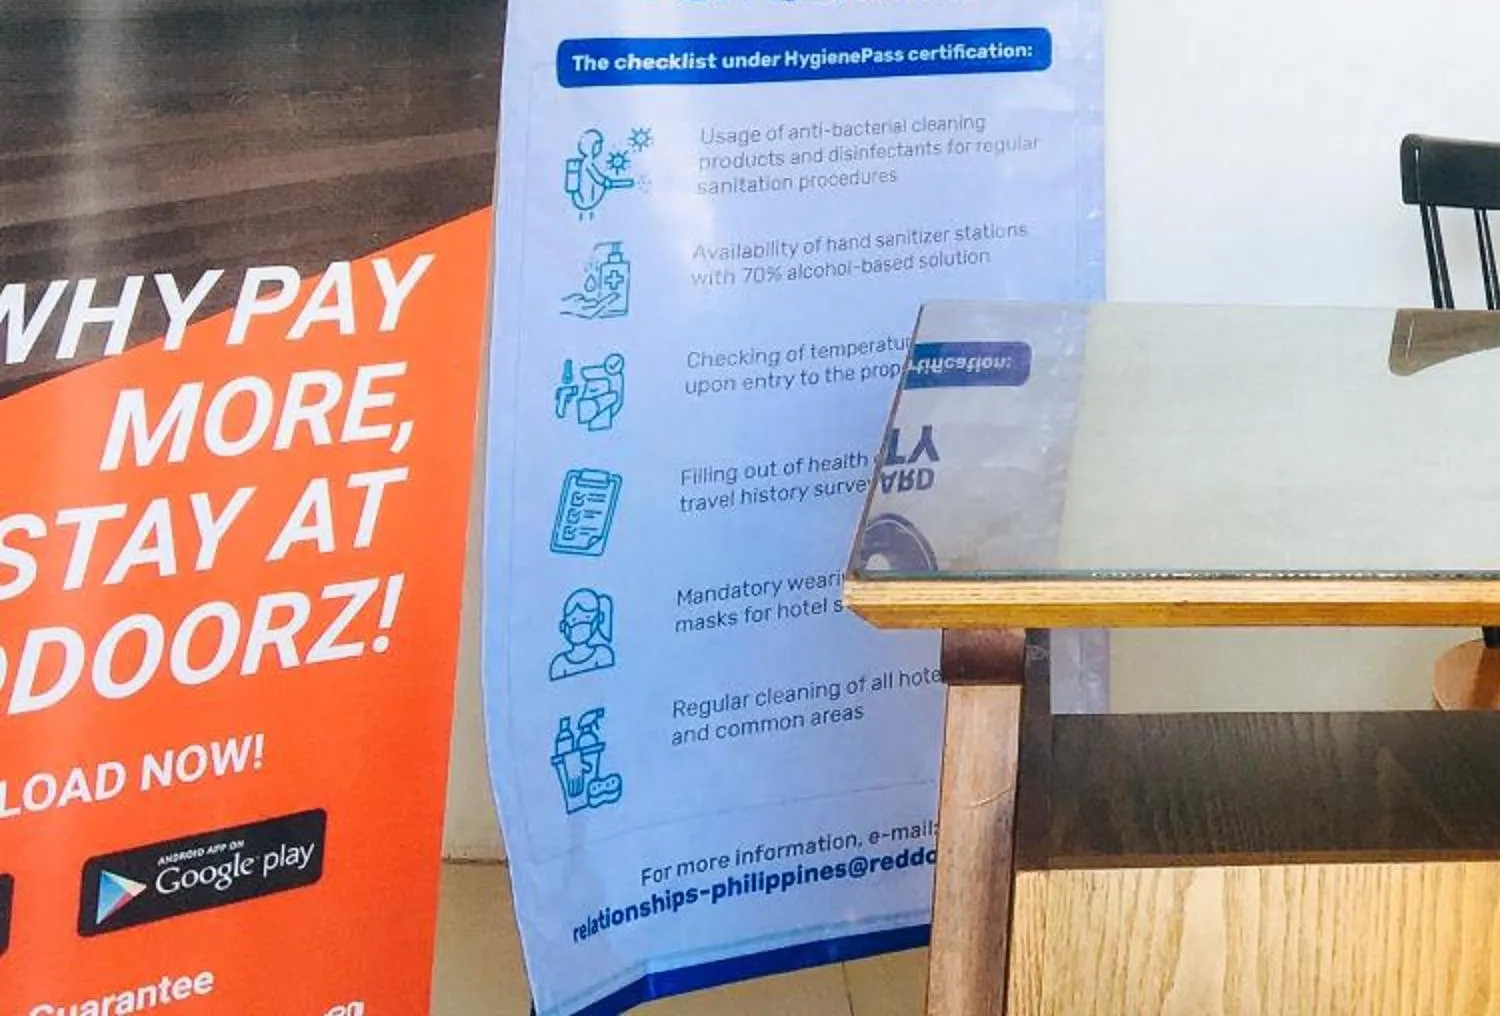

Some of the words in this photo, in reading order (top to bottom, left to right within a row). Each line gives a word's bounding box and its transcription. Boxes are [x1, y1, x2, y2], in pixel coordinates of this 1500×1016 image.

[572, 54, 610, 72] The
[613, 52, 717, 71] checklist
[722, 51, 781, 68] under
[784, 47, 905, 69] HygienePass
[908, 42, 1034, 62] certification:
[701, 127, 762, 147] Usage
[766, 126, 787, 142] of
[788, 119, 907, 139] anti-bacterial
[911, 114, 987, 134] cleaning
[698, 151, 786, 171] products
[790, 148, 823, 165] and
[828, 142, 942, 163] disinfectants
[946, 139, 972, 155] for
[975, 136, 1042, 158] regular
[697, 175, 793, 196] sanitation
[798, 168, 898, 192] procedures
[692, 241, 799, 262] Availability
[803, 238, 823, 254] of
[826, 235, 872, 252] hand
[874, 229, 950, 247] sanitizer
[953, 223, 1029, 242] stations
[690, 268, 736, 287] with
[742, 266, 783, 285] 70%
[786, 255, 914, 281] alcohol-based
[918, 248, 991, 269] solution
[0, 268, 225, 365] WHY
[225, 252, 437, 346] PAY
[686, 349, 781, 370] Checking
[786, 343, 806, 363] of
[685, 377, 737, 396] upon
[742, 373, 795, 392] entry
[799, 369, 819, 386] to
[825, 363, 855, 383] the
[99, 361, 415, 473] MORE,
[680, 464, 738, 487] Filling
[744, 461, 778, 480] out
[783, 456, 806, 476] of
[808, 450, 868, 472] health
[679, 493, 735, 513] travel
[740, 483, 811, 506] history
[814, 479, 872, 498] surve
[0, 486, 257, 602] STAY
[264, 466, 410, 563] AT
[676, 578, 783, 607] Mandatory
[675, 609, 738, 633] masks
[744, 605, 770, 625] for
[777, 598, 828, 620] hotel
[0, 572, 405, 716] DOORZ!
[672, 694, 751, 719] Regular
[755, 681, 841, 708] cleaning
[846, 675, 866, 696] of
[871, 672, 893, 691] all
[671, 724, 710, 747] and
[715, 713, 805, 741] common
[810, 704, 865, 727] areas
[0, 761, 126, 819] LOAD
[140, 732, 266, 791] NOW!
[155, 852, 256, 895] Google
[262, 841, 315, 879] play
[157, 848, 205, 866] ANDROID
[206, 843, 229, 856] APP
[230, 839, 245, 851] ON
[640, 865, 672, 887] For
[676, 852, 731, 876] more
[734, 830, 864, 866] information,
